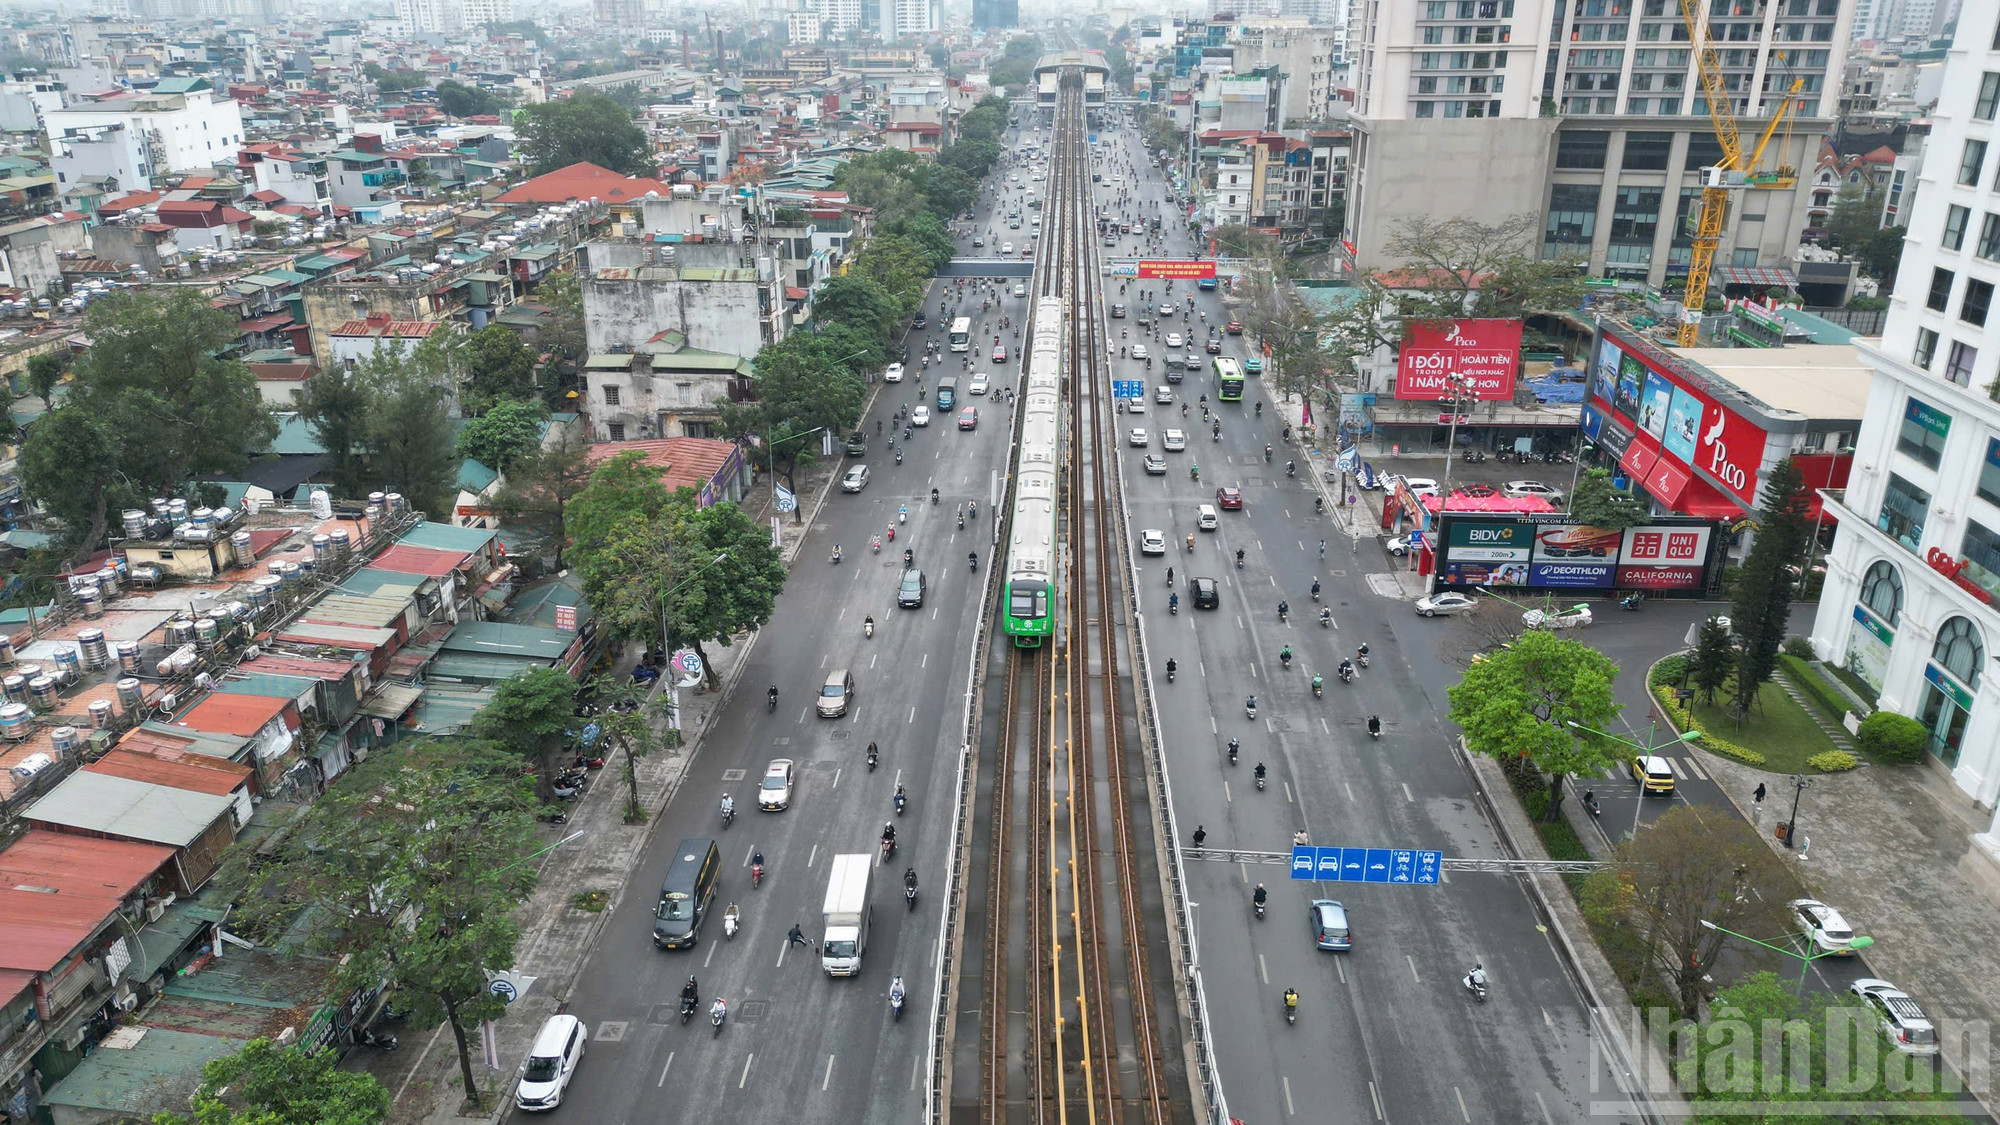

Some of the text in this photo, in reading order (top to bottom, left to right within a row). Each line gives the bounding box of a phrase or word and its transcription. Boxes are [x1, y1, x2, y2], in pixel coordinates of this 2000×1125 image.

[1415, 352, 1444, 369] ĐỔI
[1461, 353, 1510, 365] HOÀN TIỀN
[1416, 375, 1446, 388] NĂM
[1478, 379, 1499, 388] HƠN
[1469, 529, 1502, 541] BIDV
[1671, 536, 1693, 545] UNI
[1669, 546, 1692, 557] QLO
[1553, 566, 1607, 575] DECATHLON
[1625, 571, 1693, 579] CALIFORNIA
